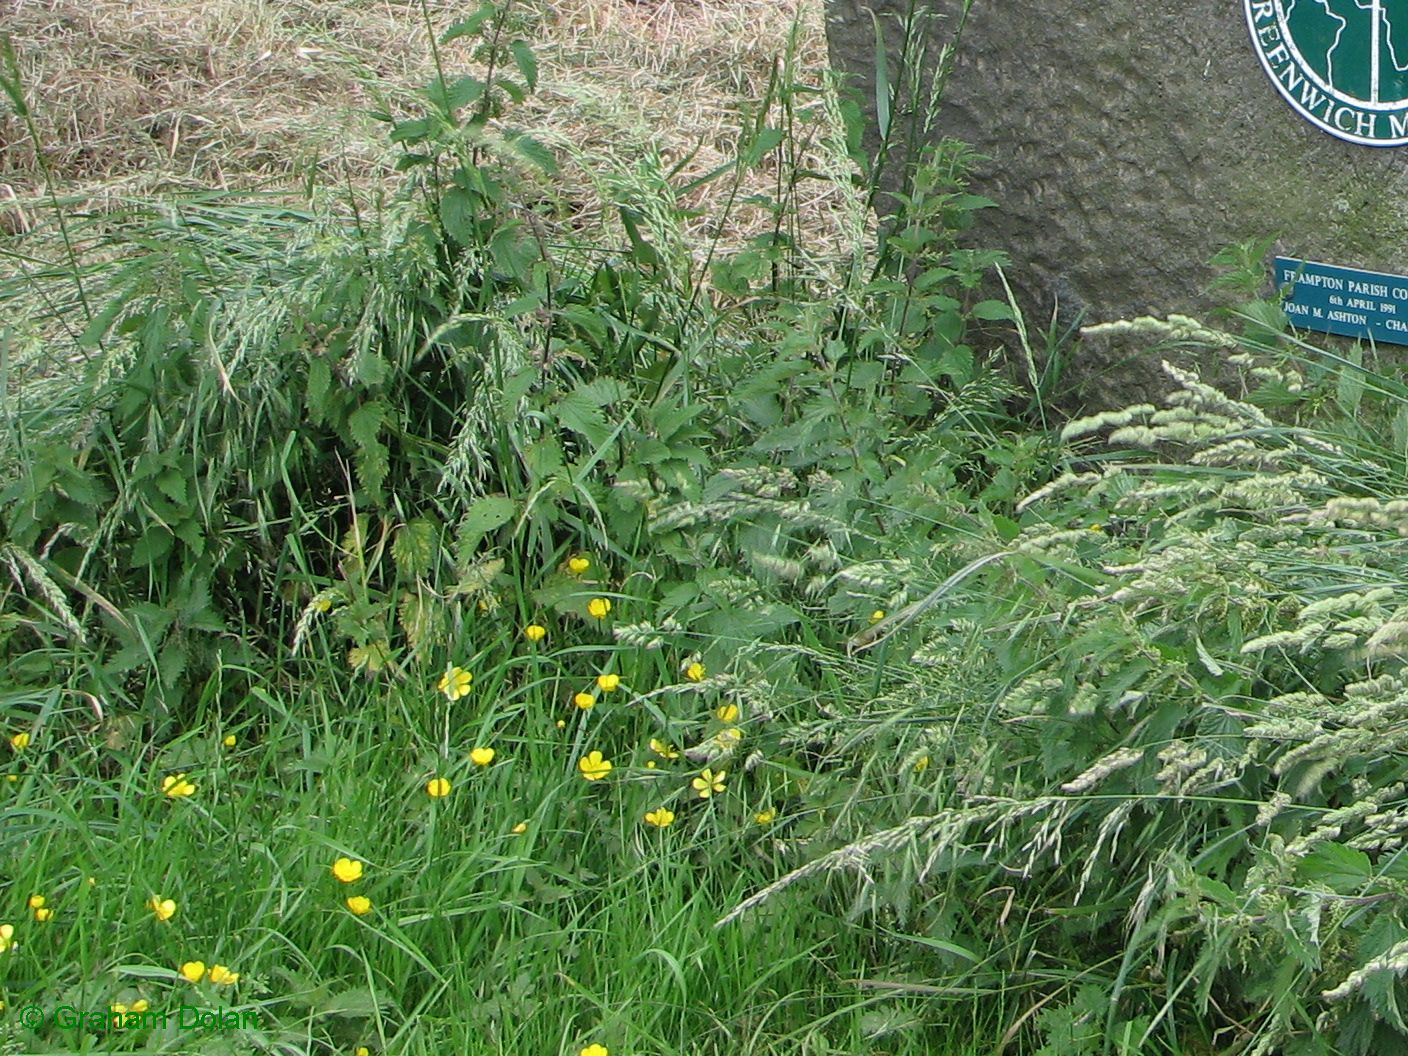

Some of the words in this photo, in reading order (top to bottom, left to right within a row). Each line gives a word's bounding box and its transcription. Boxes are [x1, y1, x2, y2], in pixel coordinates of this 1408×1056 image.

[1348, 280, 1388, 298] PARISH
[1329, 294, 1343, 306] 6th
[1346, 297, 1376, 311] APRIL
[1283, 301, 1309, 315] JOAN
[1327, 310, 1367, 325] ASHTON
